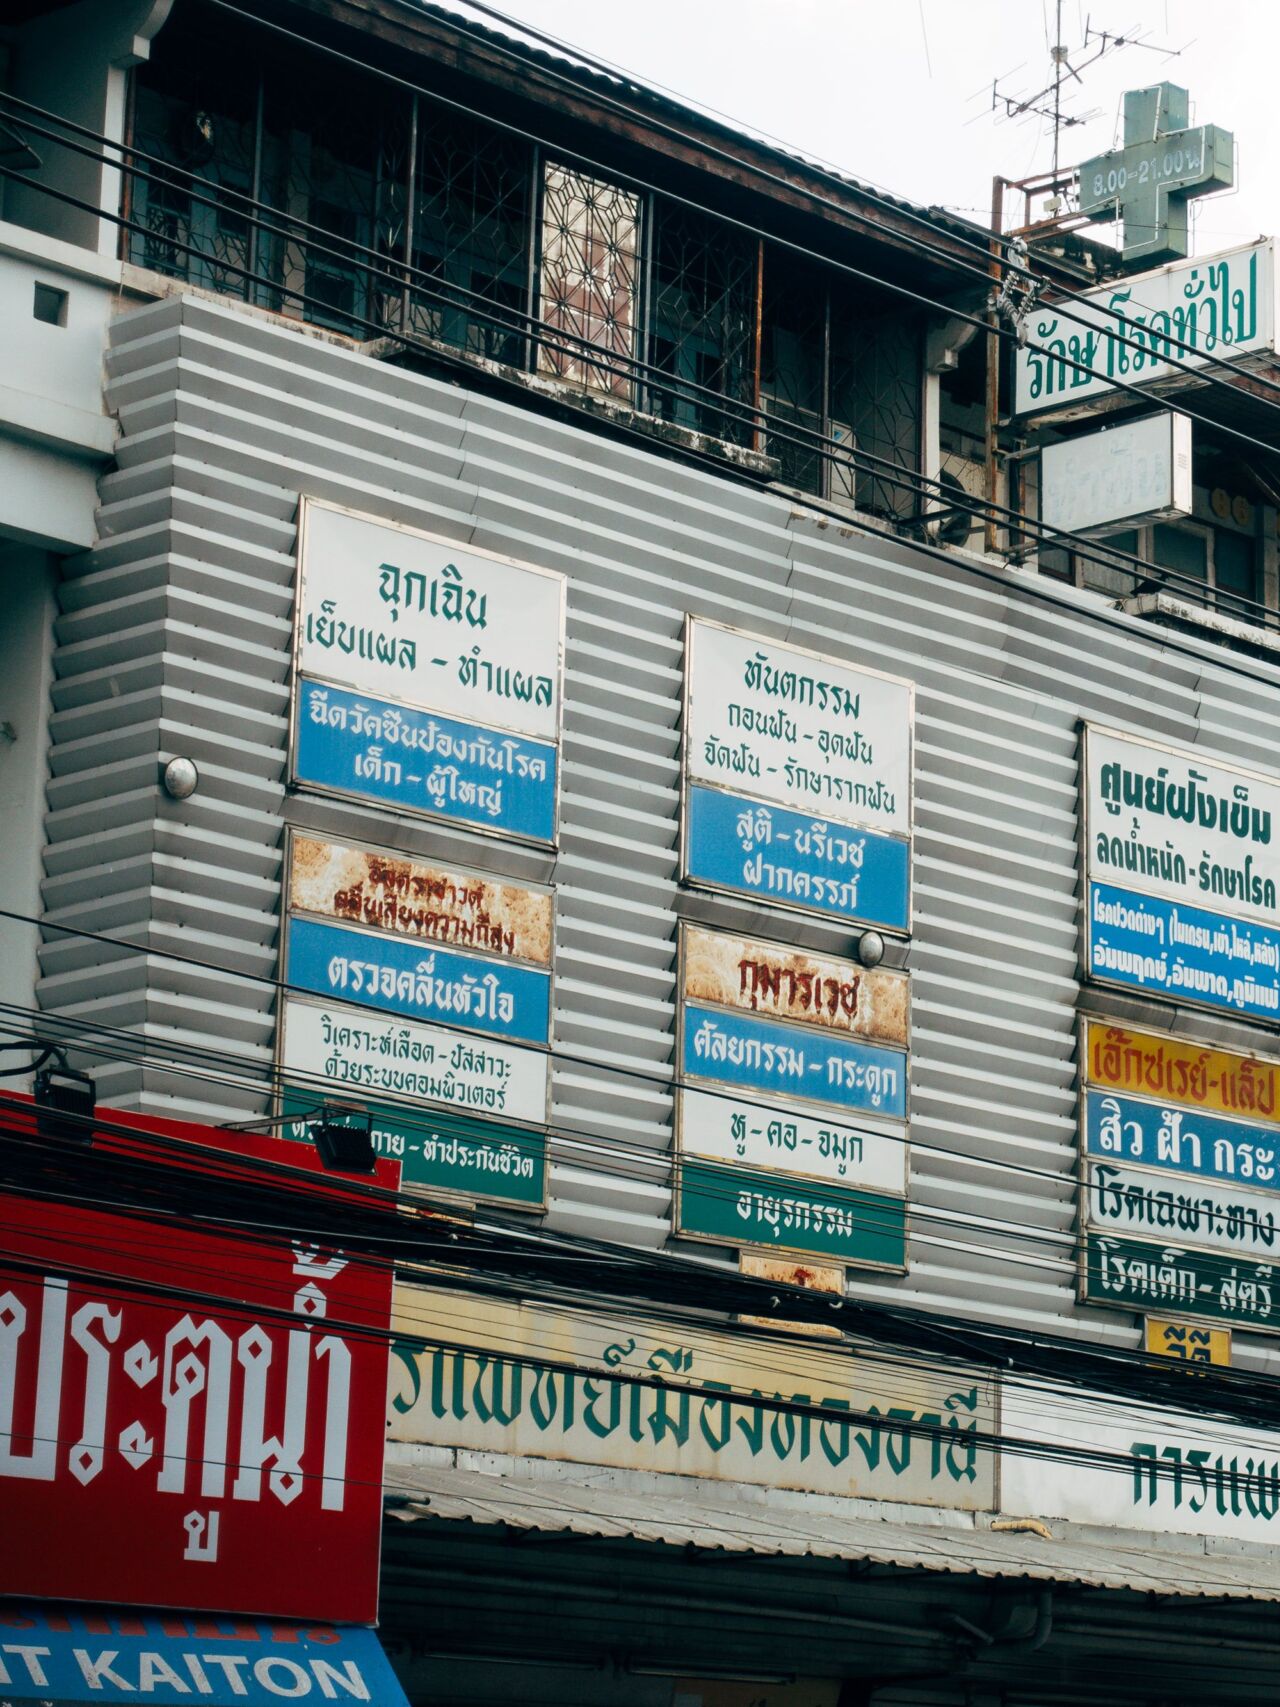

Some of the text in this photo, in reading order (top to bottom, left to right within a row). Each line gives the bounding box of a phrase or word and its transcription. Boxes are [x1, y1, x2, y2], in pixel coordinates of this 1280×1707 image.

[1027, 251, 1258, 399] รักษาโรคทั่วไป
[379, 563, 487, 629] ฉุกเฉิน
[307, 600, 416, 671] เย็บแผล
[458, 646, 552, 708] ทำแผล
[744, 652, 859, 719] ทันตกรรม
[310, 691, 546, 782] ฉีดวัคซีนป้องกันโรค
[819, 730, 872, 765] อุดฟัน
[355, 745, 401, 785] เด็ก
[427, 764, 502, 816] ผู้ใหญ่
[704, 734, 760, 778] จัดฟัน
[784, 756, 895, 814] รักษารากฟัน
[1100, 762, 1271, 844] ศูนย์ฝังเข็ม
[795, 823, 866, 868] นรีเวช
[743, 852, 860, 909] ฝากครรภ์
[328, 954, 514, 1023] ตรวจคลื่นหัวใจ
[737, 959, 861, 1020] กุมารเวช
[321, 1014, 434, 1064] วิเคราะห์เลือด
[694, 1020, 804, 1077] ศัลยกรรม
[827, 1056, 896, 1107] กระดูก
[325, 1049, 506, 1110] ด้วยระบบคอมพิวเตอร์
[423, 1134, 533, 1179] ทำประกันชีวิต
[731, 1113, 746, 1156] หู
[767, 1121, 797, 1151] คอ
[818, 1130, 863, 1175] จมูก
[1100, 1098, 1275, 1181] สิว ฝ้า กระ
[737, 1191, 853, 1238] อายุรกรรม
[1094, 1164, 1274, 1247] โรคเฉพาะทาง
[72, 1648, 372, 1702] KAITON
